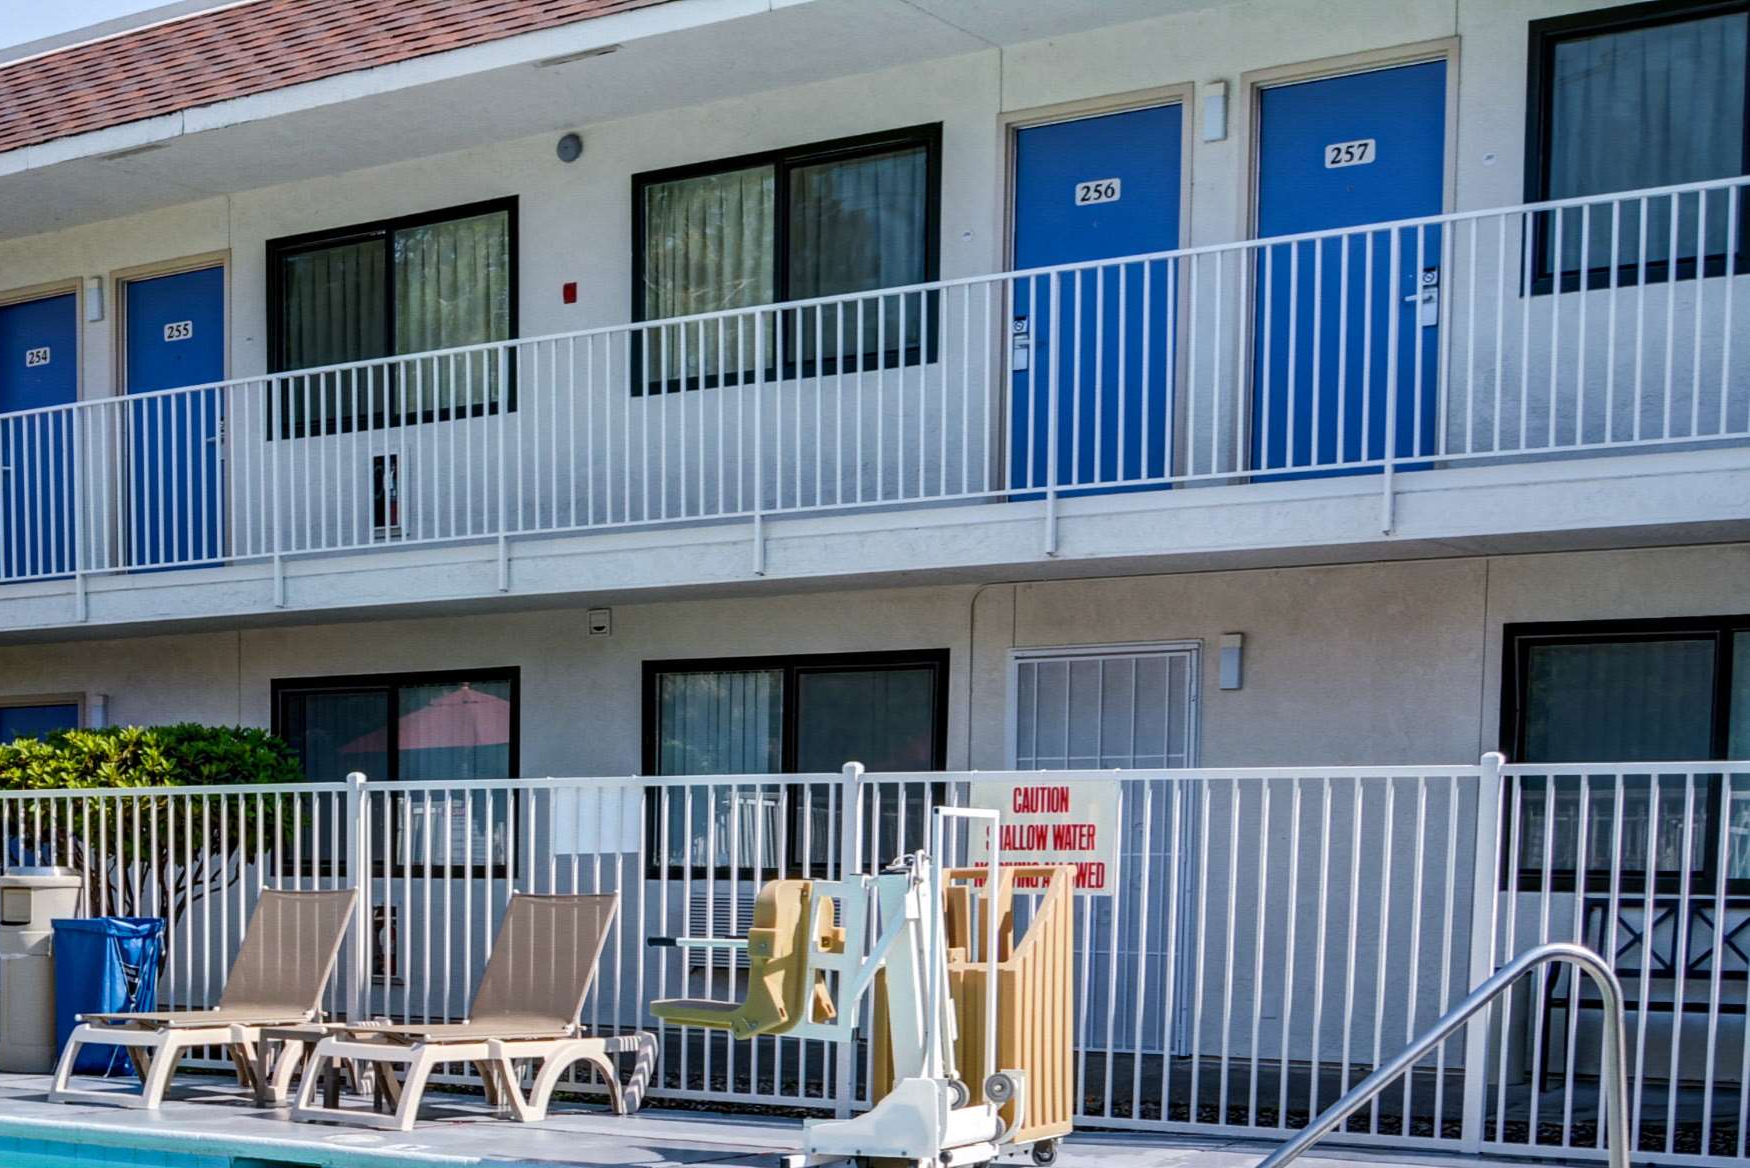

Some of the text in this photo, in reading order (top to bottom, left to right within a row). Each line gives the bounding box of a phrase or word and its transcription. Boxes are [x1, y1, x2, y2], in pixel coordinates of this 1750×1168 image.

[1331, 143, 1369, 165] 257
[1080, 182, 1115, 202] 256
[167, 323, 189, 339] 255
[29, 349, 47, 365] 254
[1013, 786, 1070, 813] CAUTION
[986, 824, 1096, 851] ALLOW WATER
